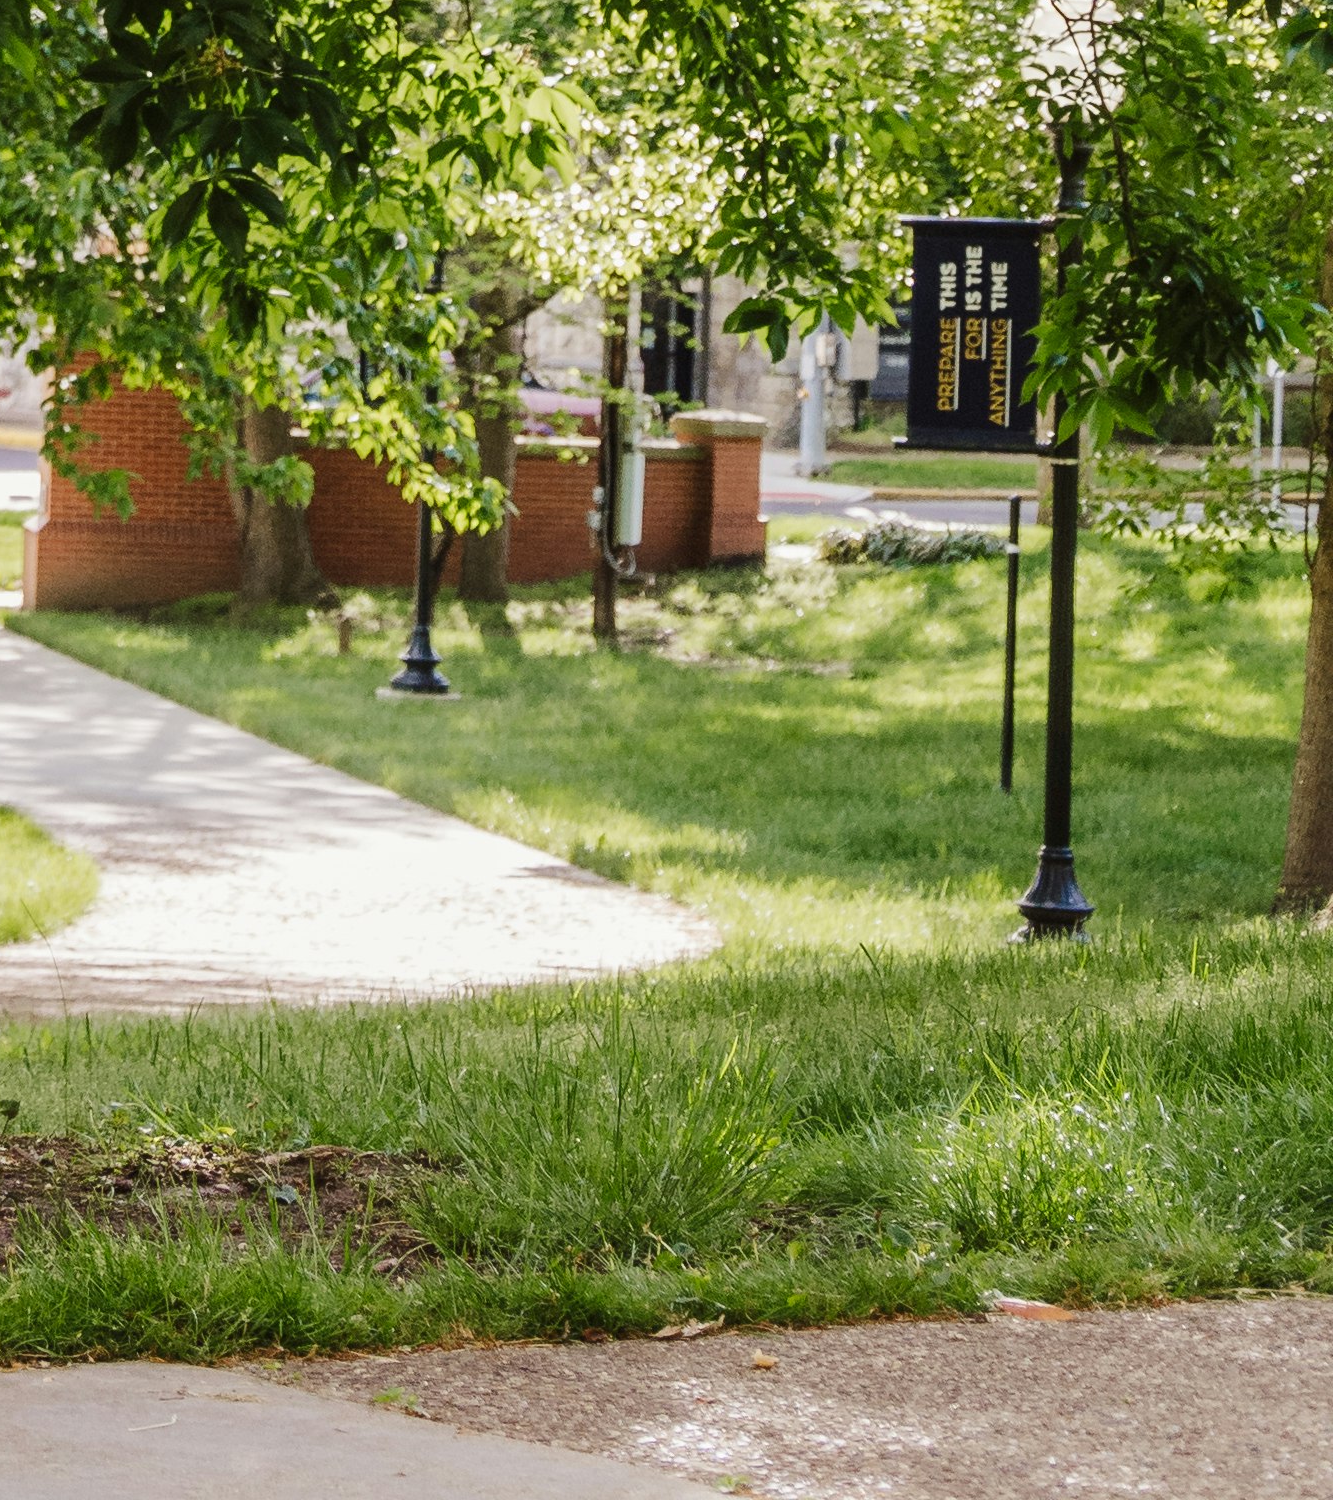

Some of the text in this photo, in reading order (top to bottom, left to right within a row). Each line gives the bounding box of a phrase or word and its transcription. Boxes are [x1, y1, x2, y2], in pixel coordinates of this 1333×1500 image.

[939, 262, 957, 311] THIS
[965, 246, 983, 311] IS THE
[991, 262, 1008, 312] TIME
[937, 317, 956, 411] PREPARE
[965, 317, 982, 360] FOR
[988, 318, 1007, 426] ANYTHING
